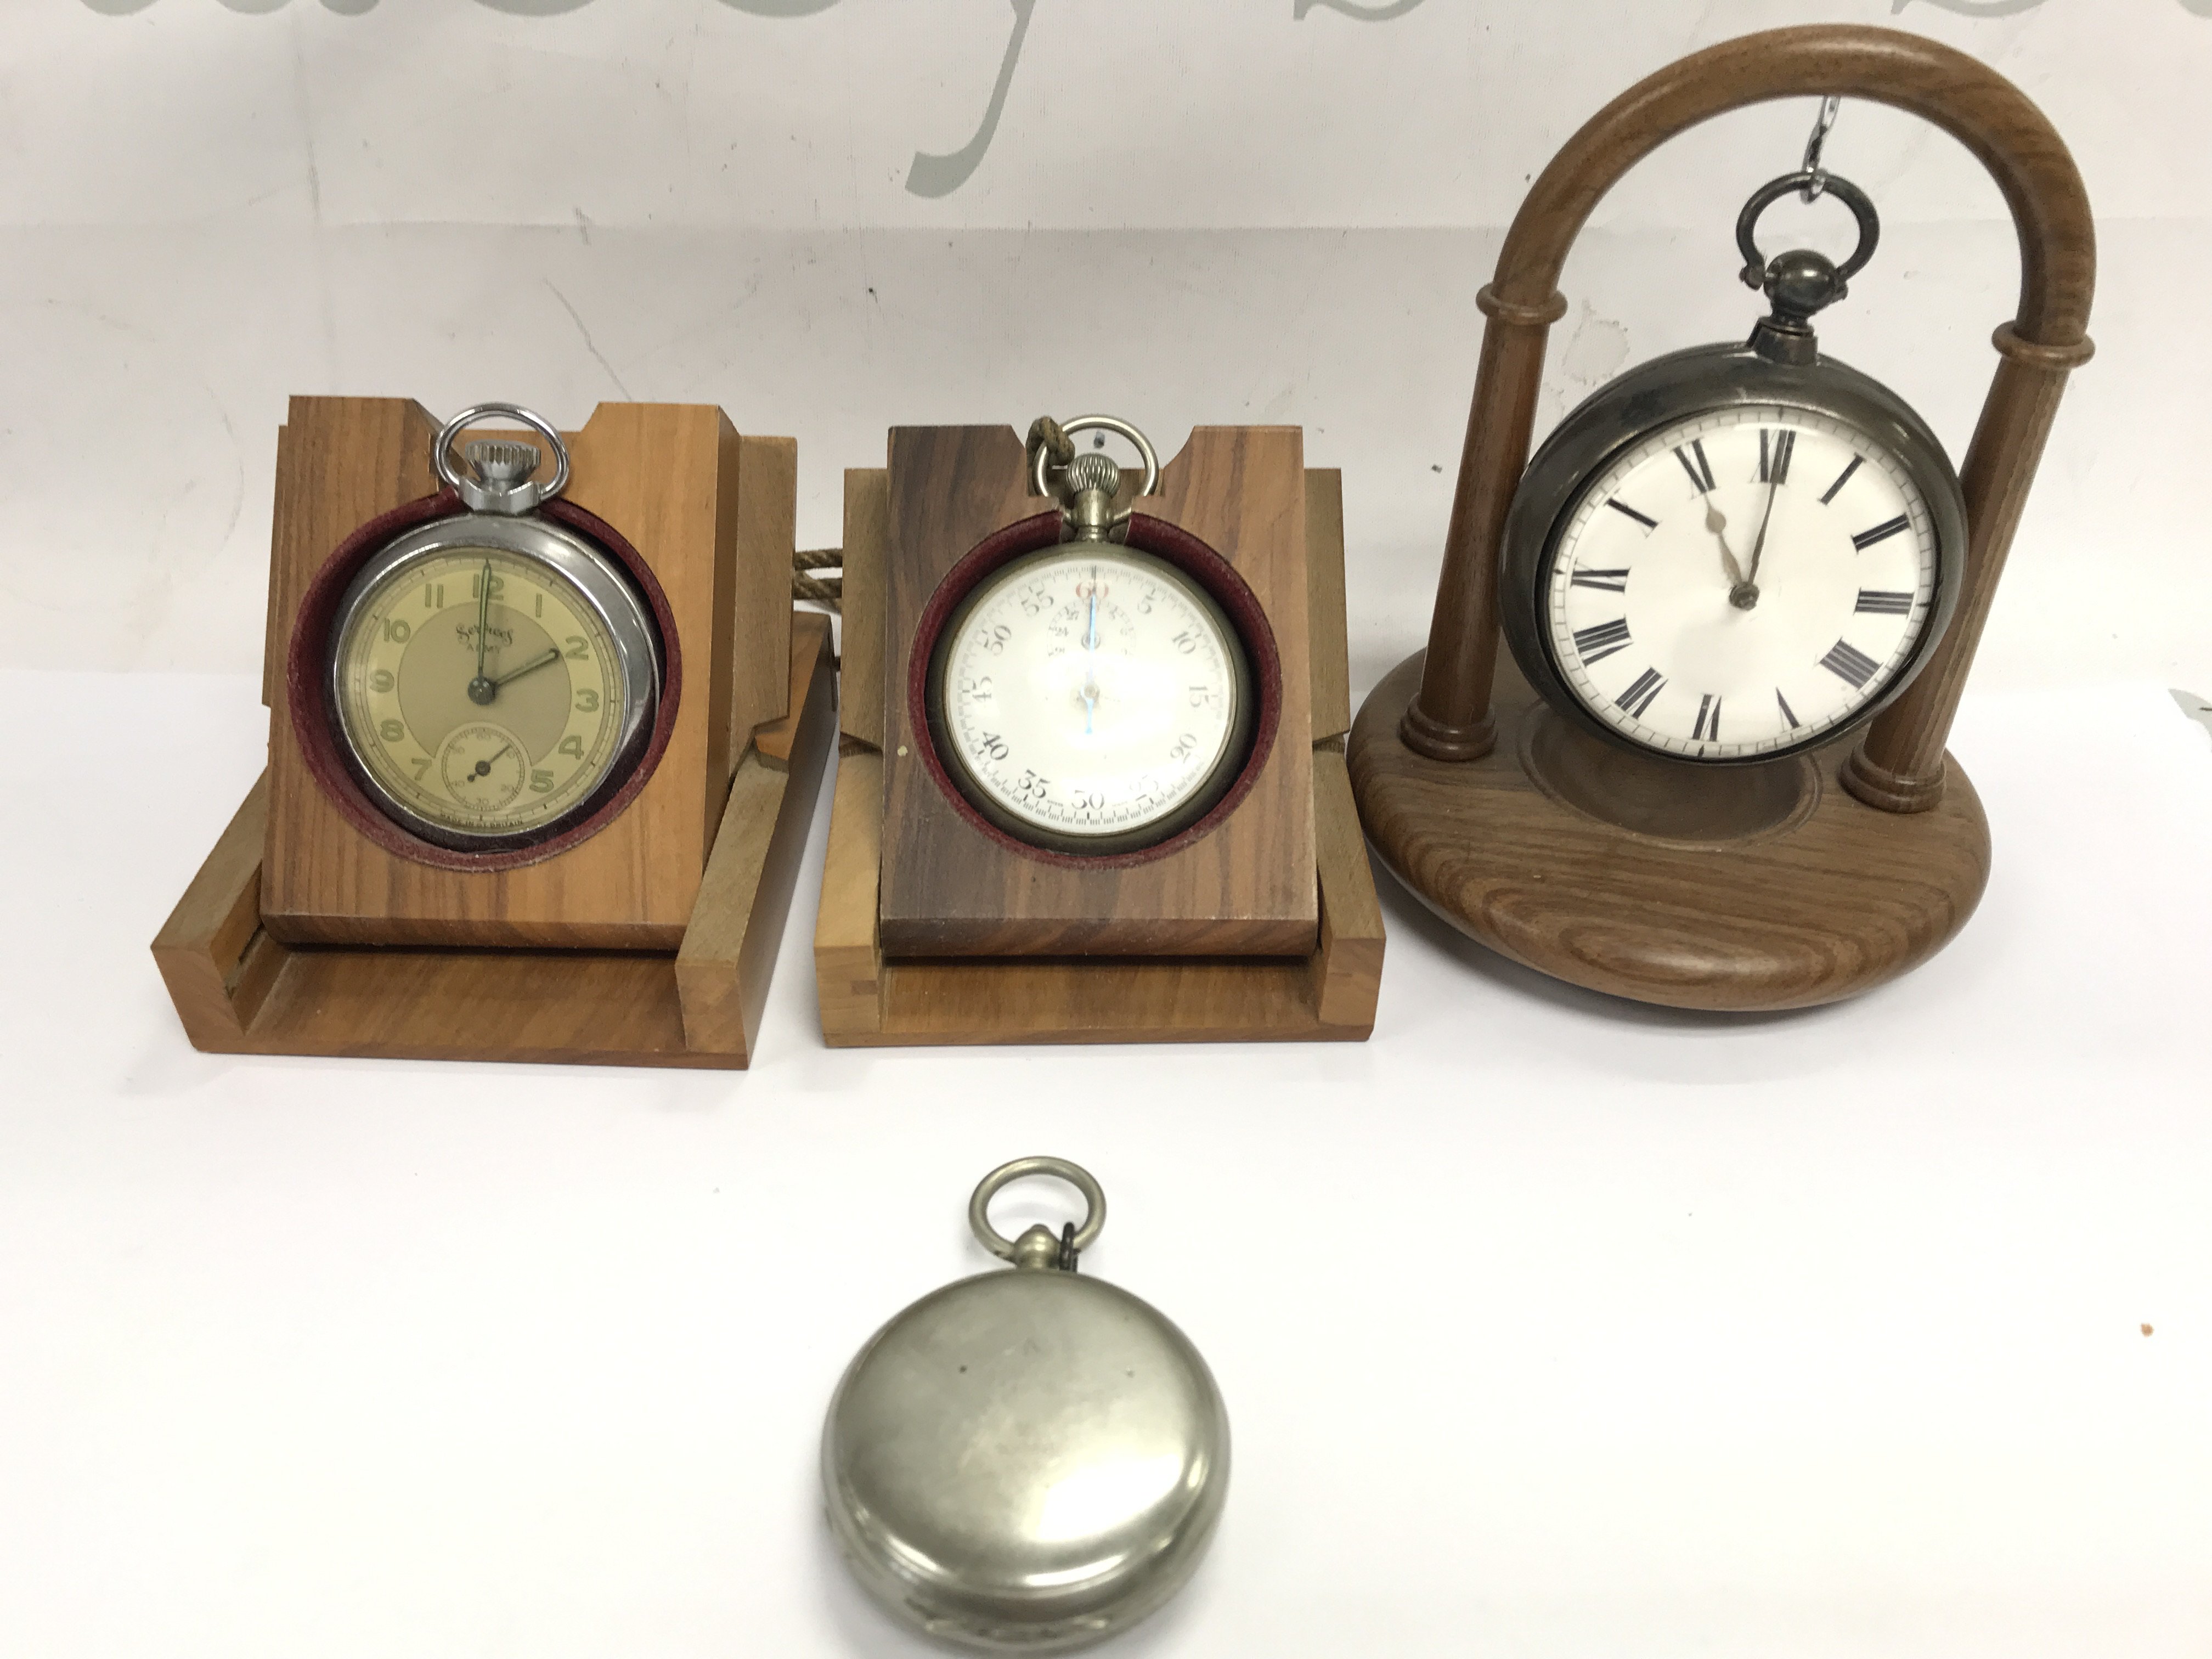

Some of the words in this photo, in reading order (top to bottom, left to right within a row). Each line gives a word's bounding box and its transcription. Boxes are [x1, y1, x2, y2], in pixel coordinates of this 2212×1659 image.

[1673, 437, 1716, 500] XI
[1749, 427, 1797, 485] XII
[1818, 452, 1866, 507] I
[1604, 488, 1661, 539] X
[1850, 512, 1911, 554] II
[473, 573, 504, 601] 12
[1570, 557, 1630, 594] IX
[425, 584, 443, 608] 11
[1022, 589, 1054, 617] 55
[1076, 580, 1109, 600] 60
[1853, 586, 1916, 615] III
[535, 593, 543, 618] 1
[1137, 595, 1154, 614] 5
[384, 618, 411, 644] 10
[984, 624, 1012, 656] 50
[1172, 631, 1197, 654] 10
[1573, 613, 1634, 667] VIII
[565, 636, 589, 661] 2
[1812, 636, 1886, 690] IIII
[370, 669, 394, 693] 9
[972, 676, 992, 702] 45
[1614, 665, 1669, 720] VII
[575, 689, 600, 713] 3
[1188, 686, 1209, 708] 15
[1775, 686, 1801, 732] V
[380, 719, 405, 742] 8
[1691, 693, 1723, 743] VI
[558, 735, 584, 760] 4
[982, 731, 1009, 761] 40
[1170, 733, 1197, 764] 20
[411, 758, 432, 781] 7
[529, 770, 555, 793] 5
[1018, 769, 1050, 798] 35
[1071, 789, 1105, 810] 30
